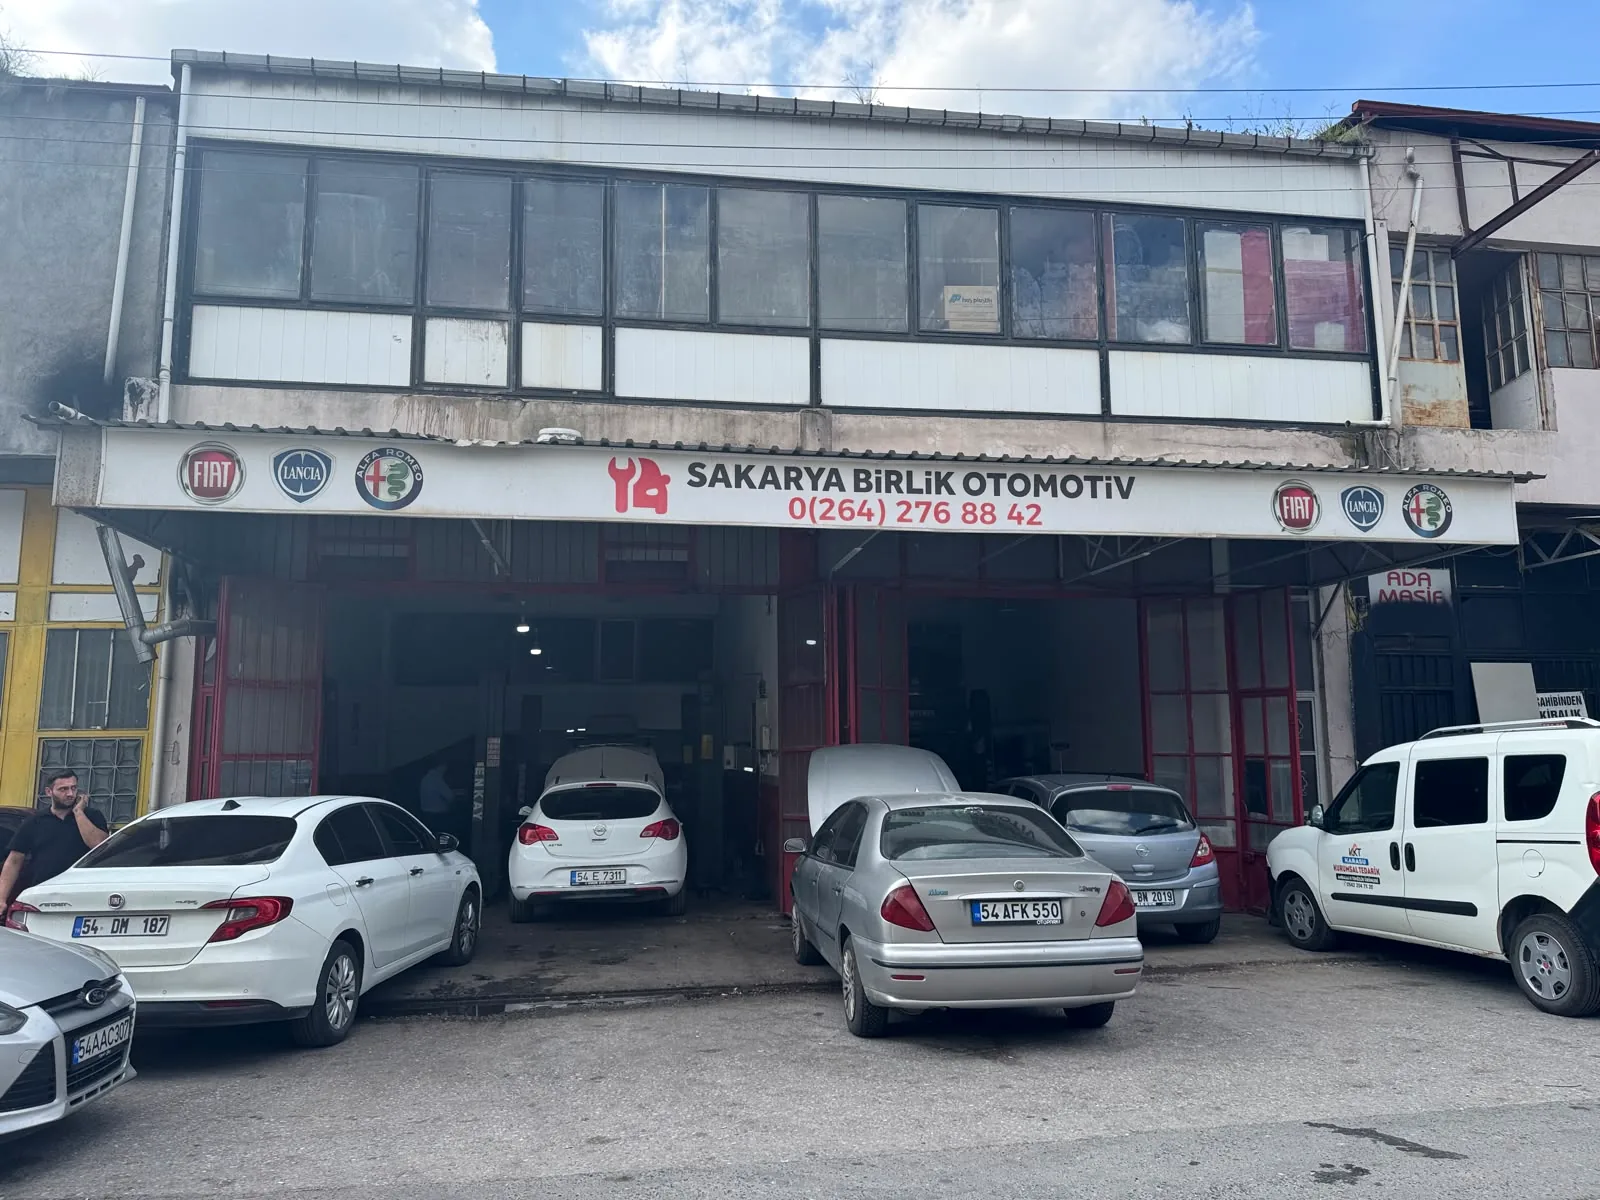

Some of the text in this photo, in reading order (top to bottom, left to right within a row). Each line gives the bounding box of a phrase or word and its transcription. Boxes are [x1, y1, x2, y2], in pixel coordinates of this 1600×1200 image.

[283, 465, 322, 481] LANCIA
[356, 448, 423, 481] ALFA ROMEO
[193, 461, 232, 488] FIAT
[687, 462, 847, 492] SAKARYA
[1348, 500, 1378, 514] LANCIA
[1402, 484, 1452, 513] ALFA ROMEO
[788, 496, 1043, 527] 0(264) 276 88 42
[1282, 496, 1311, 520] FIAT
[1387, 571, 1432, 587] ADA
[577, 870, 622, 881] 54 E 7311
[1137, 891, 1173, 902] BN 2019
[981, 903, 1000, 920] 54
[1002, 903, 1030, 919] AFK
[1032, 902, 1059, 919] 550
[81, 919, 99, 935] 54
[110, 918, 130, 934] DM
[143, 917, 168, 934] 187
